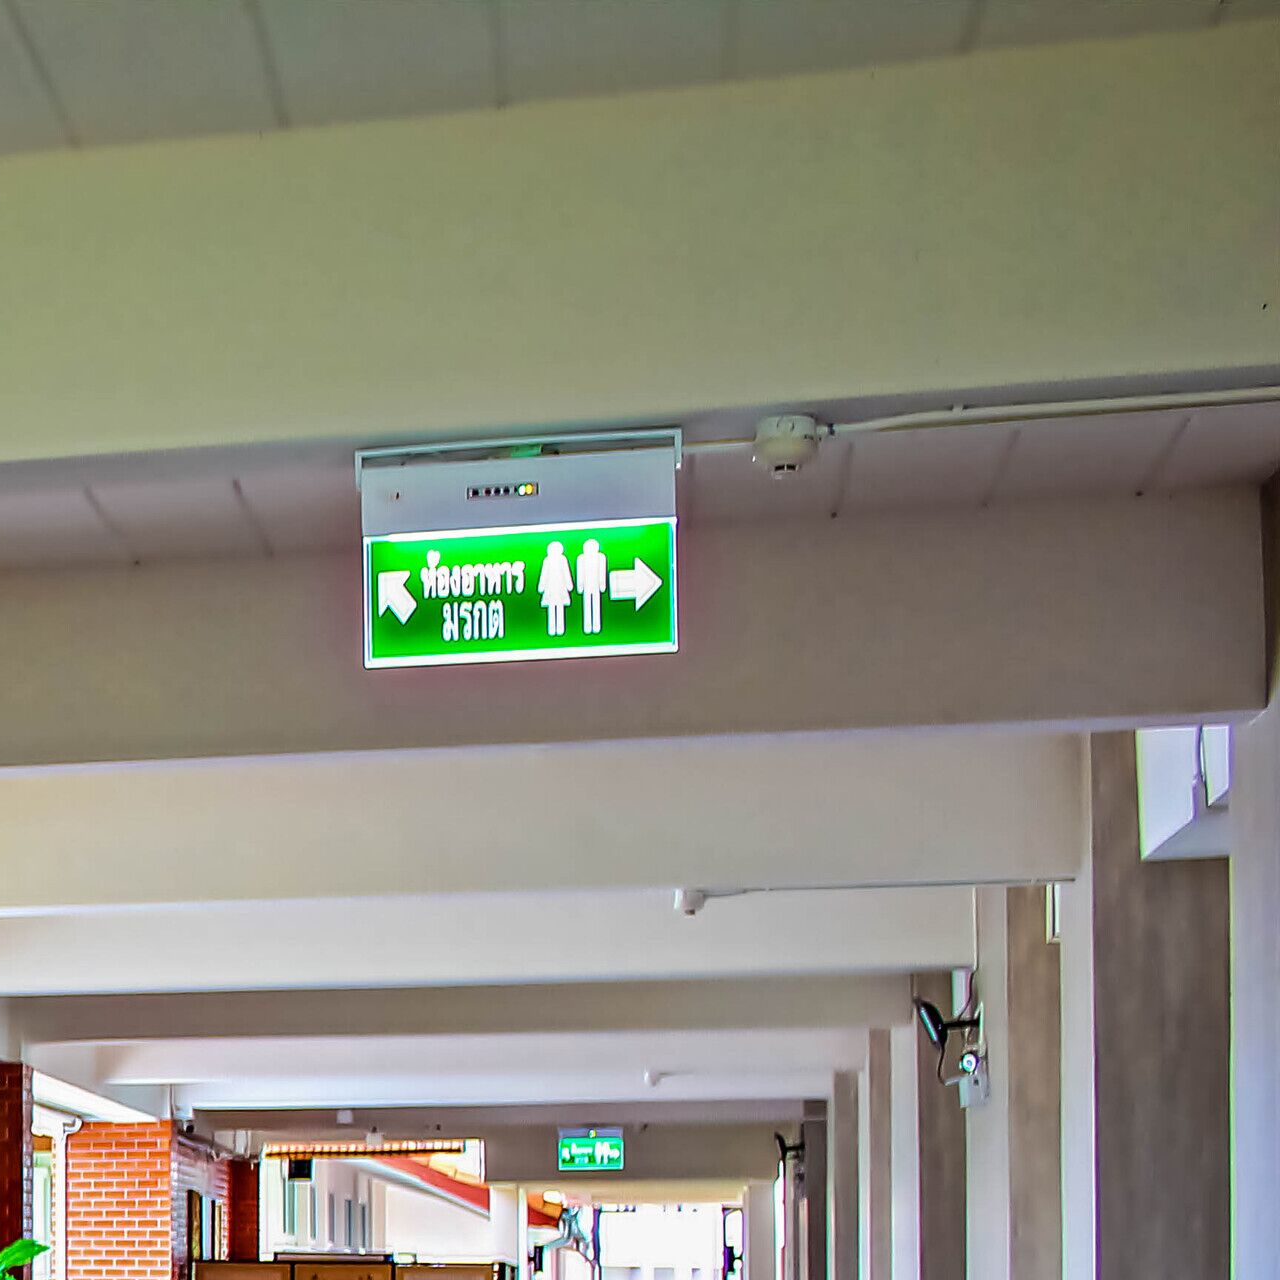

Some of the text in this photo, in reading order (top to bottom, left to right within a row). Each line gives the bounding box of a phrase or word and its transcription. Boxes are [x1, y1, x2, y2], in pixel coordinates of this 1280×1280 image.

[421, 549, 525, 599] ห้องอาหาร
[442, 600, 505, 641] มรกต
